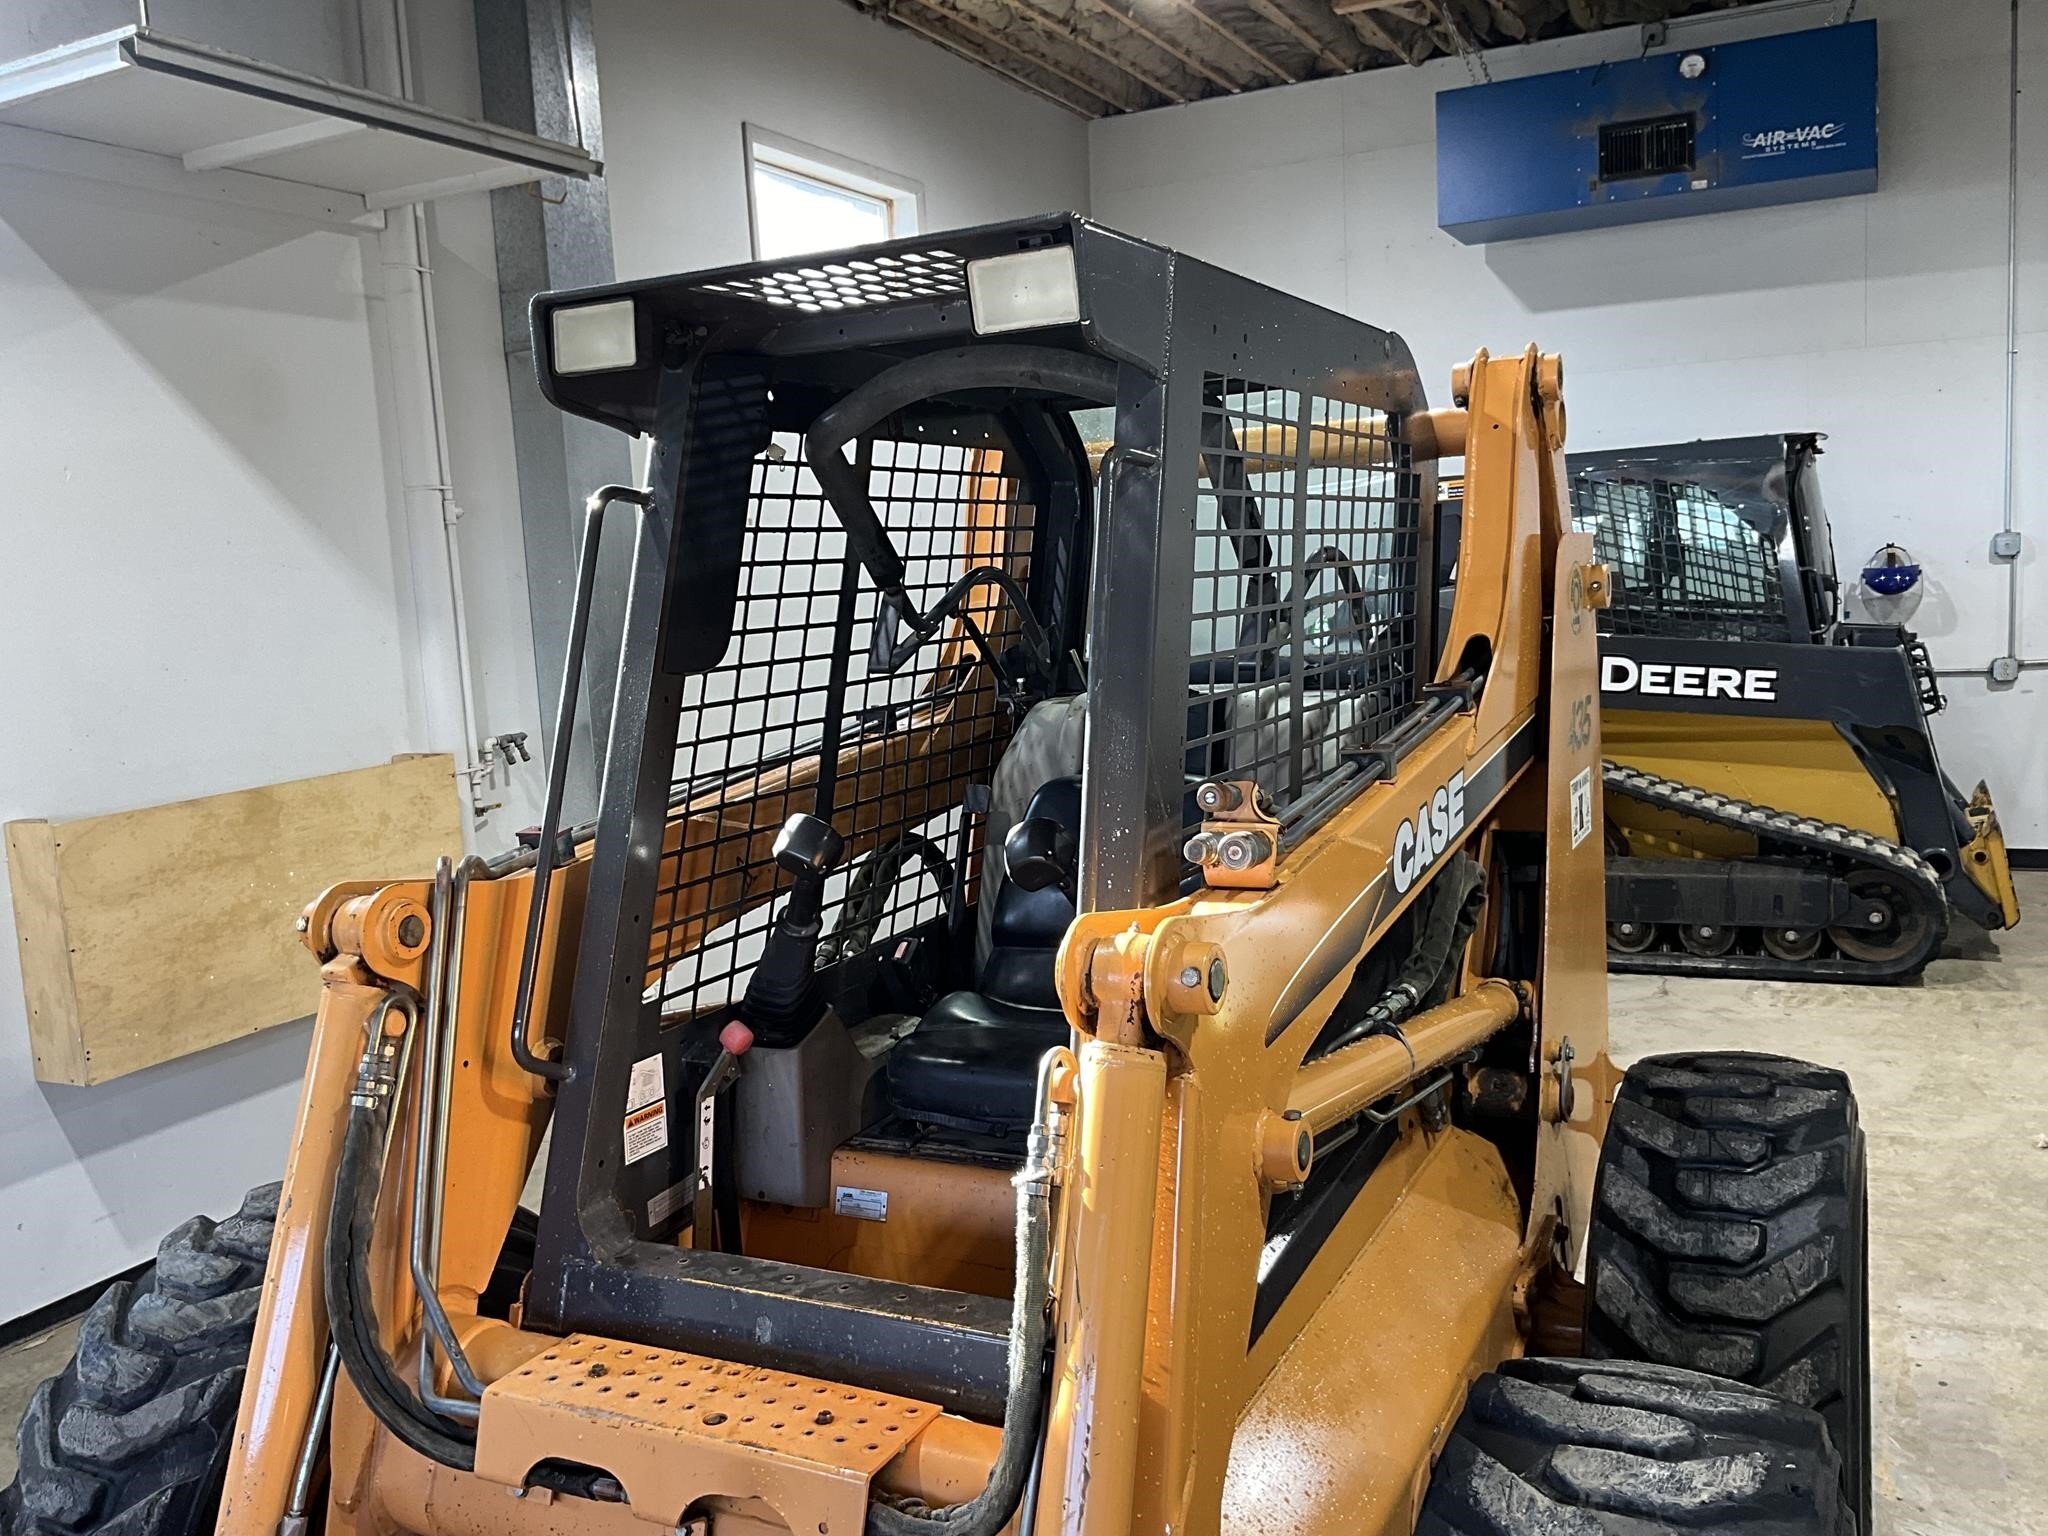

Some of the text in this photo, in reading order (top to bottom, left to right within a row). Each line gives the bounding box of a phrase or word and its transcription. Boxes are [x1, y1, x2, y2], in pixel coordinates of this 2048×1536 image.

[1765, 140, 1817, 153] SYSTEMS
[1600, 656, 1778, 701] DEERE
[1393, 769, 1465, 894] CASE
[634, 1106, 663, 1124] WARNING
